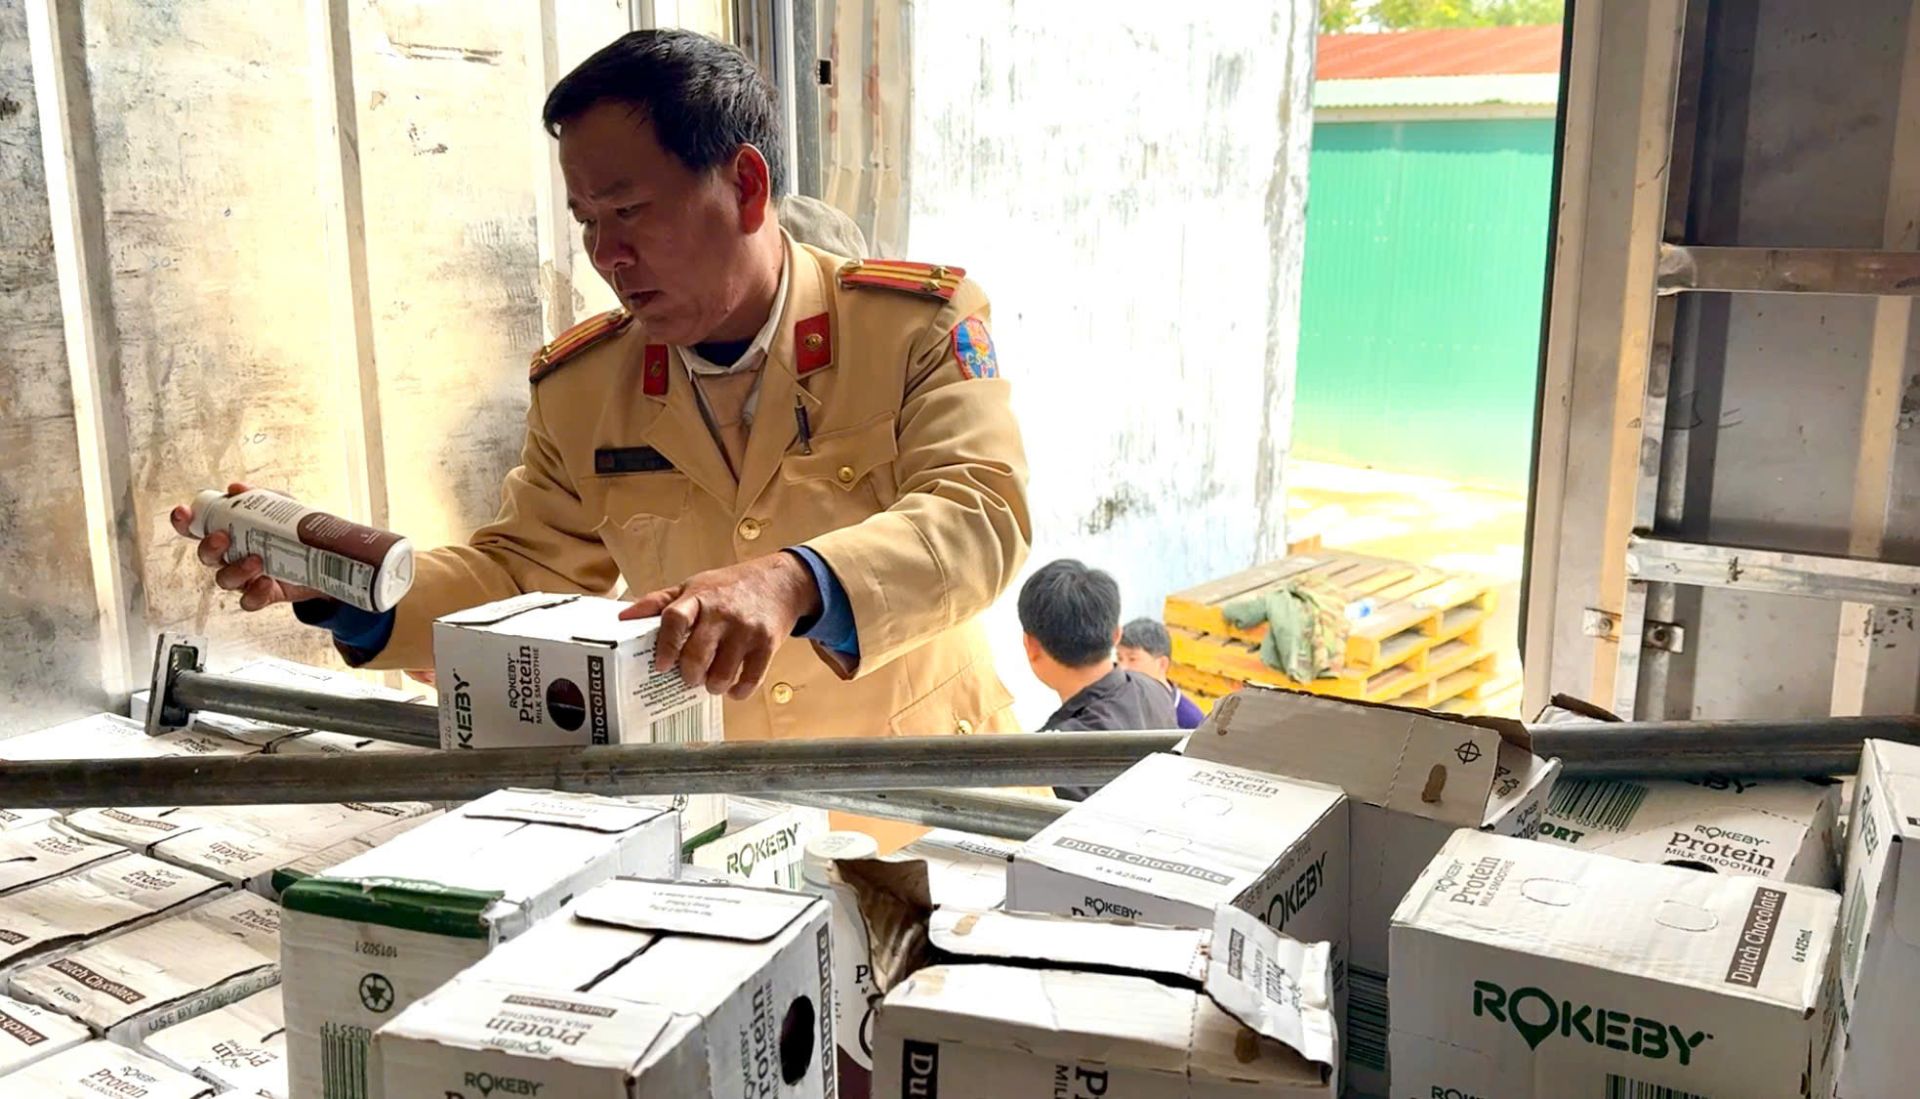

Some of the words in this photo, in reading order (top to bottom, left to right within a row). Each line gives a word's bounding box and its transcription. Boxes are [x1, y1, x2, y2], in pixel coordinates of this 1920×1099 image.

[507, 652, 521, 709] ROKEBY
[519, 645, 534, 724] Protein
[533, 647, 541, 698] SMOOTHIE
[453, 667, 473, 749] KEBY
[1193, 771, 1279, 795] Protein
[727, 821, 800, 878] ROKEBY
[1668, 832, 1776, 870] Protein
[1694, 825, 1770, 846] ROKEBY
[1061, 838, 1119, 859] Dutch
[1124, 854, 1227, 884] Chocolate
[1450, 856, 1501, 906] Protein
[1665, 847, 1695, 860] MILK
[1700, 855, 1771, 878] SMOOTHIE
[1085, 896, 1142, 919] ROKEBY
[1257, 850, 1328, 932] OKEBY
[1744, 890, 1779, 946] Chocolate
[53, 959, 88, 980] Dutch
[85, 975, 139, 1003] Chocolate
[1731, 946, 1762, 983] Dutch
[148, 1012, 175, 1032] USE
[176, 1004, 194, 1021] BY
[818, 935, 833, 1071] Chocolate
[1473, 980, 1714, 1066] ROKEBY
[485, 1017, 587, 1046] Protein
[89, 1068, 148, 1098] Protein
[464, 1072, 544, 1098] ROKEBY
